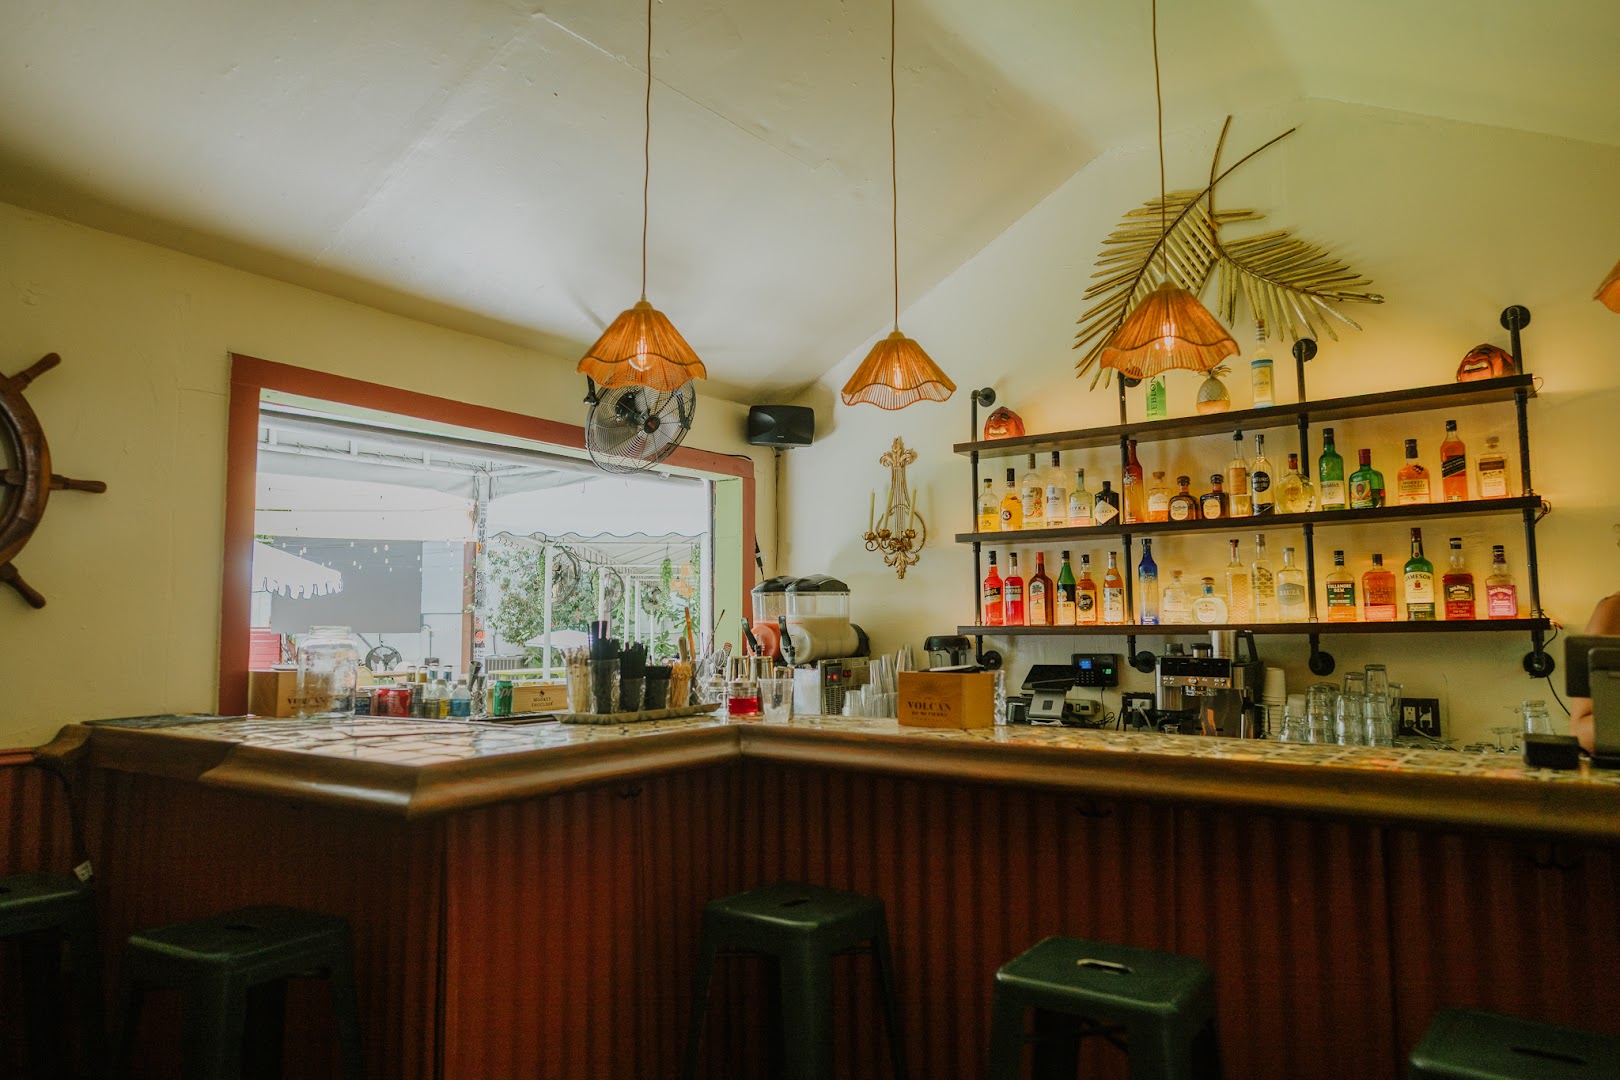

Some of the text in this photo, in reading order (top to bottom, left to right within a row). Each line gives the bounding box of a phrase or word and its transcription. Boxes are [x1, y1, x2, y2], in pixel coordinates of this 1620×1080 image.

[1150, 376, 1158, 416] LEBLON
[1406, 573, 1431, 581] JAMESON
[908, 701, 951, 711] VOLCAN
